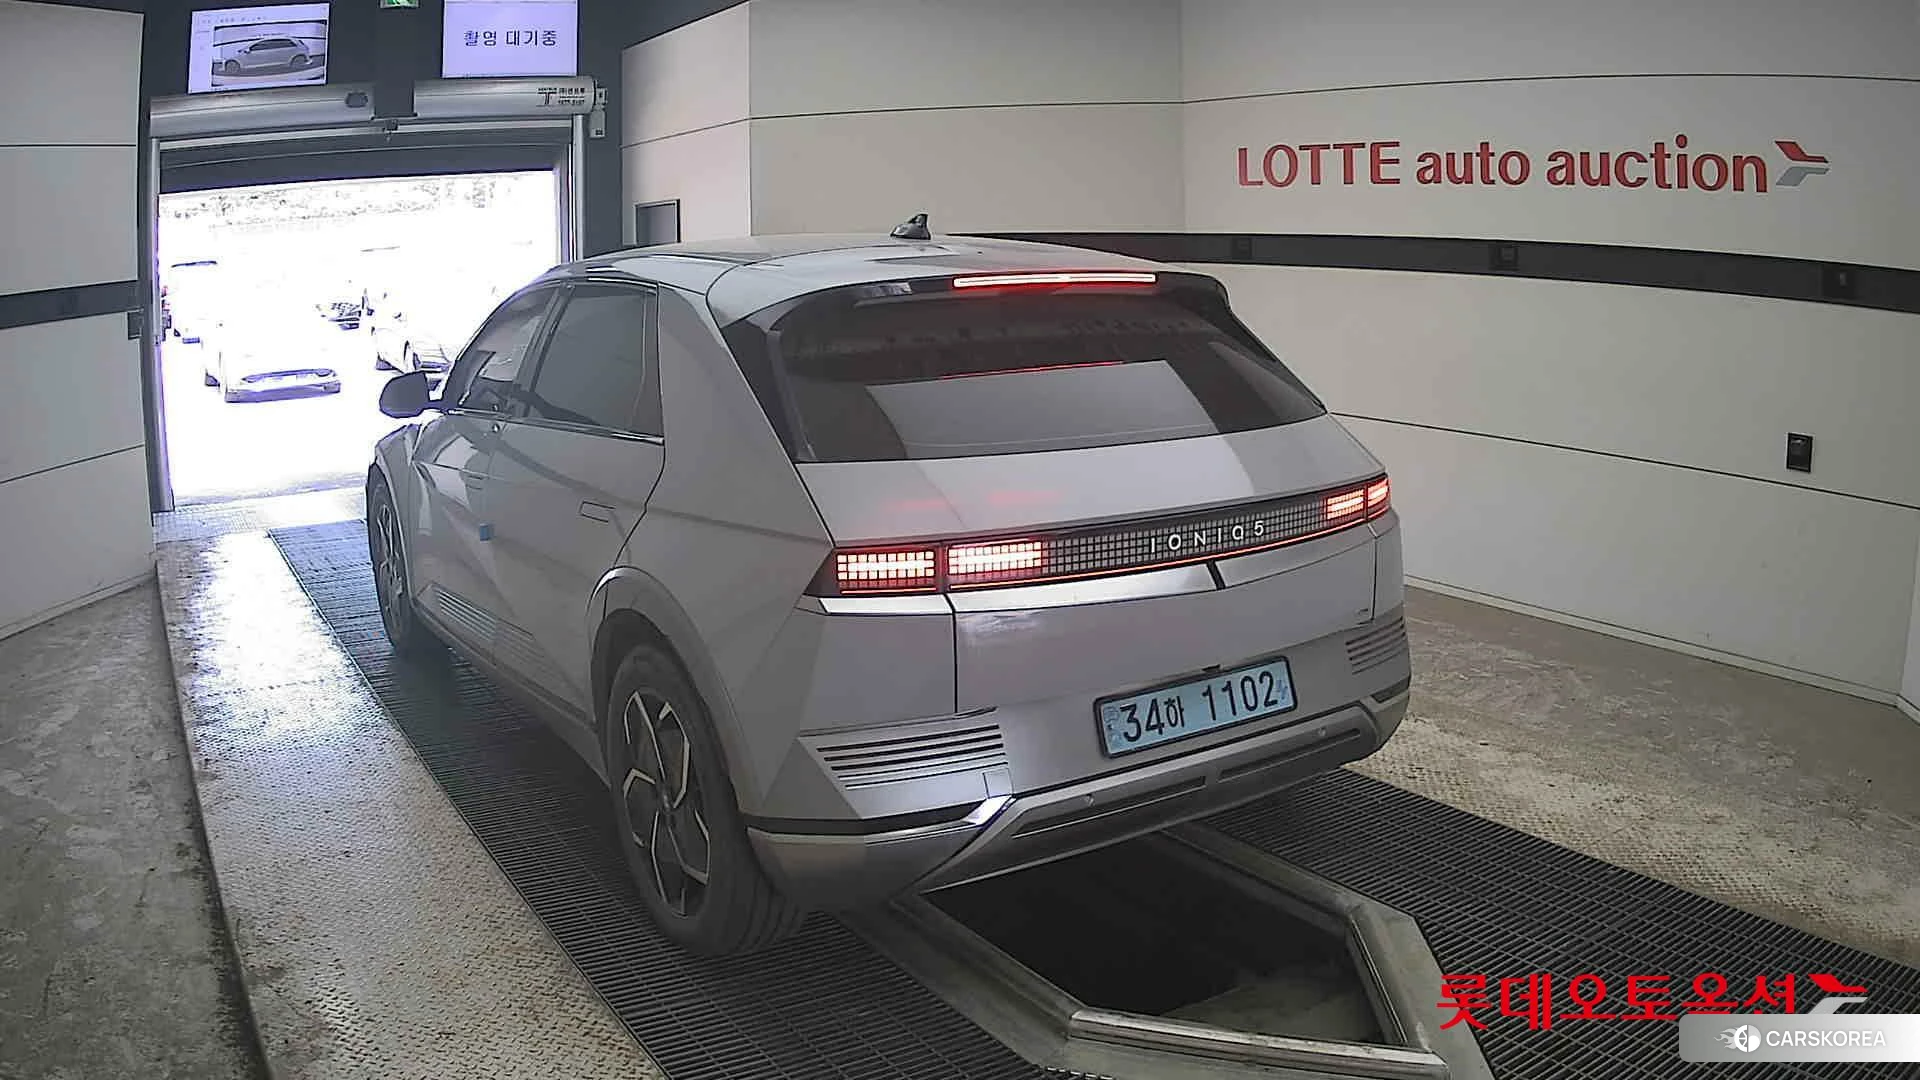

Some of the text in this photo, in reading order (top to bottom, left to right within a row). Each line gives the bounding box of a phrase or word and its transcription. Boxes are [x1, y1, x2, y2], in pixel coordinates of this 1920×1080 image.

[464, 29, 558, 46] 촬영 대기중
[1238, 134, 1768, 193] LOTTE auto auction
[1119, 671, 1278, 742] 34하 1102
